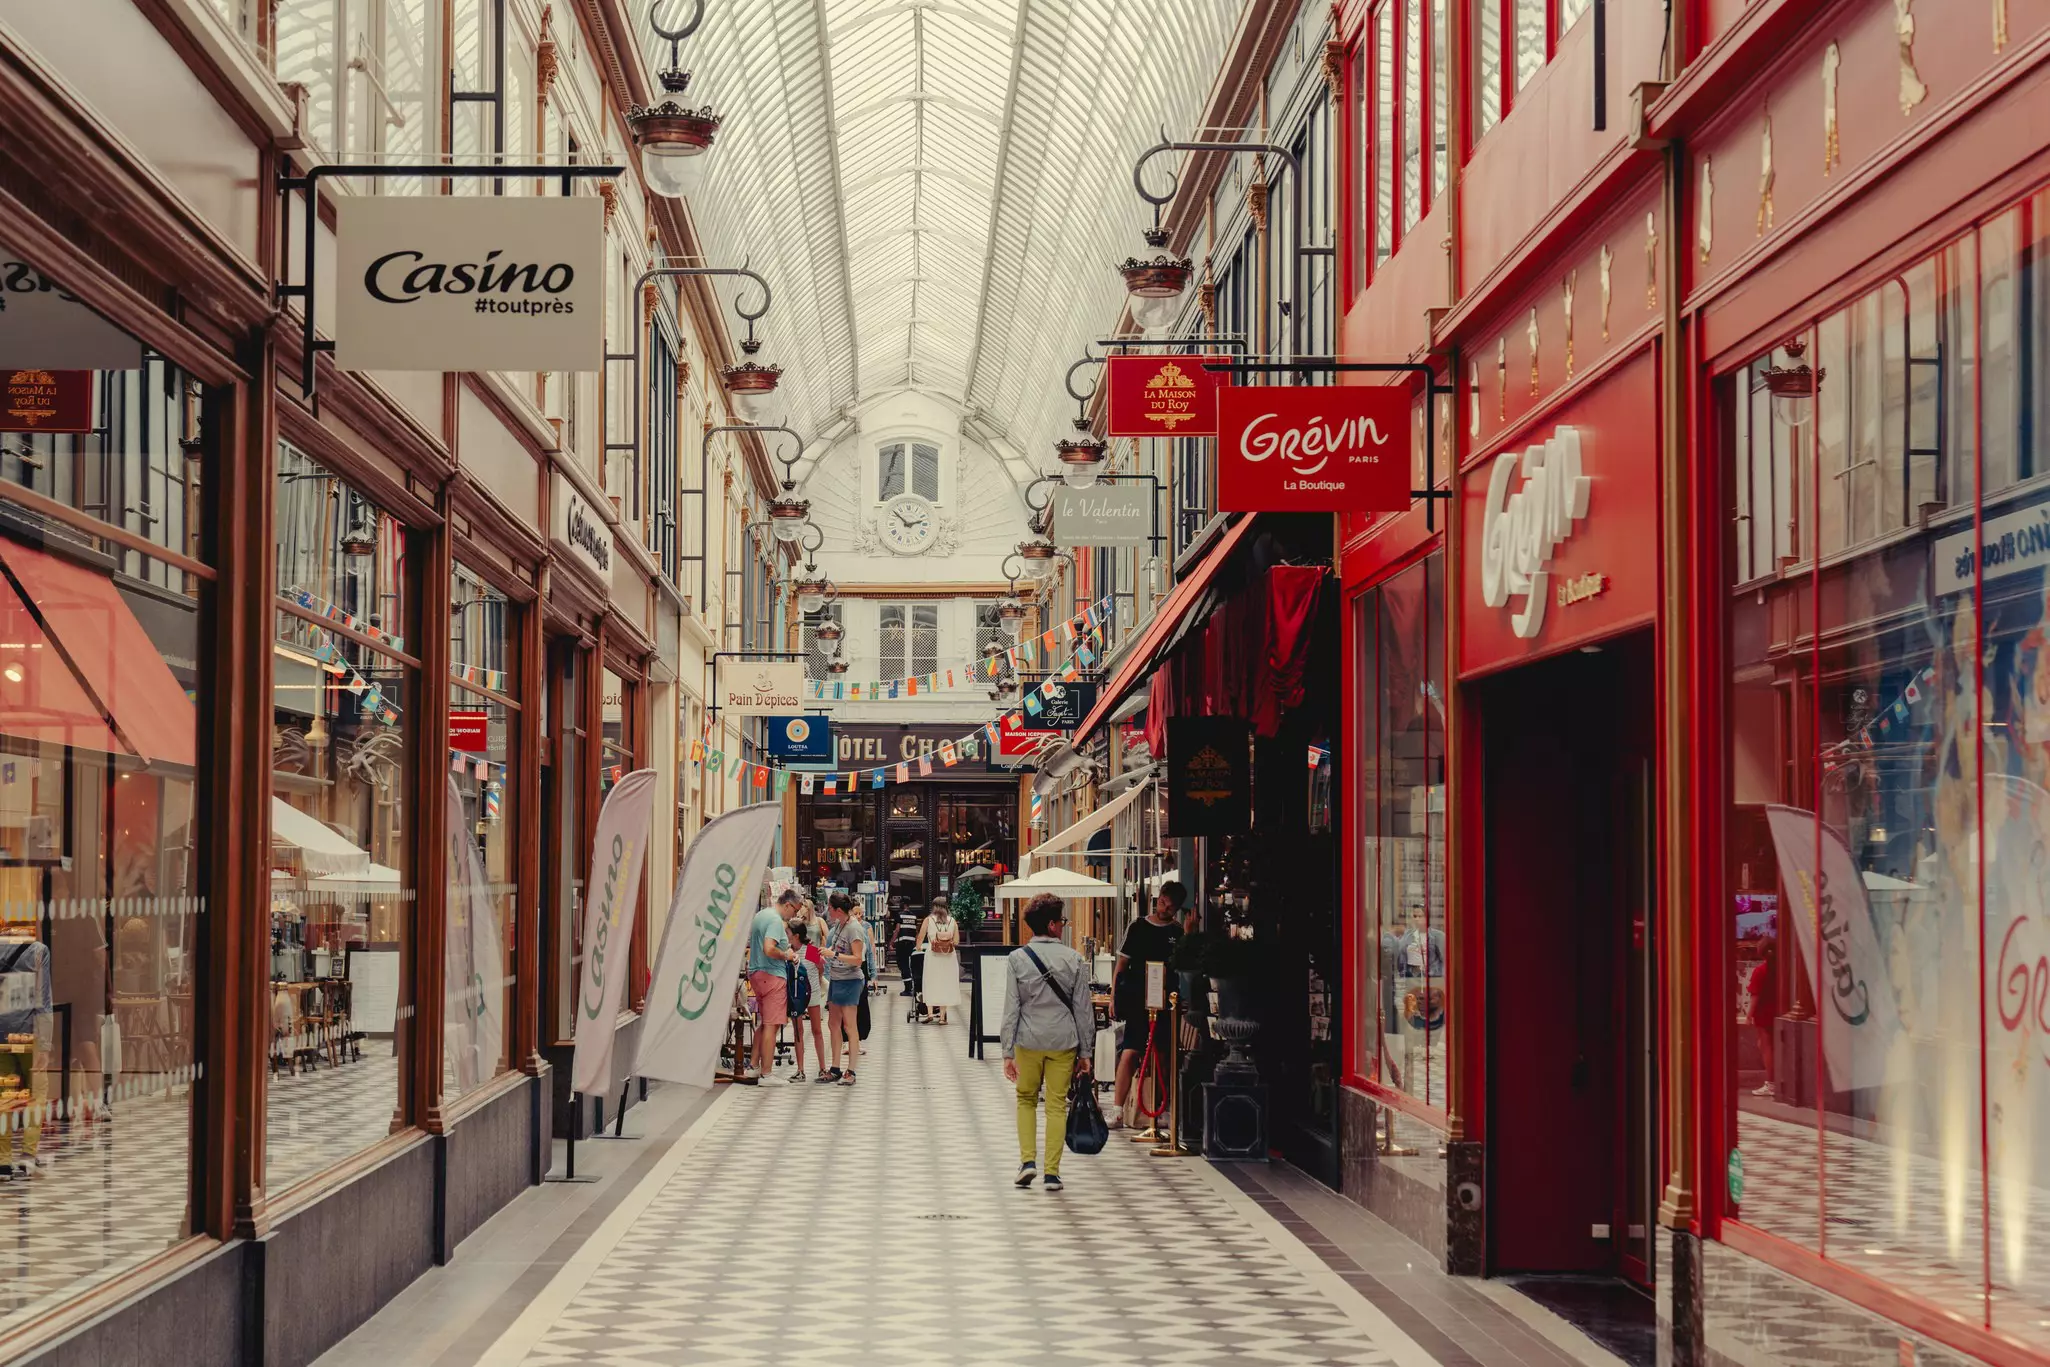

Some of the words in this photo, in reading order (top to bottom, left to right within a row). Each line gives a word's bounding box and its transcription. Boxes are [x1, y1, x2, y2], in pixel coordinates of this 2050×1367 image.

[364, 249, 574, 304] Casino
[475, 297, 574, 317] #toutprès
[1144, 390, 1156, 399] LA
[1158, 389, 1197, 399] MAISON
[1151, 401, 1166, 409] DU
[1348, 456, 1380, 464] PARIS
[1283, 480, 1298, 490] La
[1299, 480, 1346, 492] Boutique
[1062, 498, 1075, 518] le
[1079, 497, 1141, 518] Valentin
[728, 692, 753, 706] Pain
[755, 692, 799, 709] D'épices
[839, 734, 888, 762] ÔTEL
[816, 847, 861, 864] HOTEL
[892, 848, 922, 860] HOTEL
[955, 849, 1000, 865] HOTEL
[584, 833, 623, 1022] Casino
[676, 862, 737, 1022] Casino
